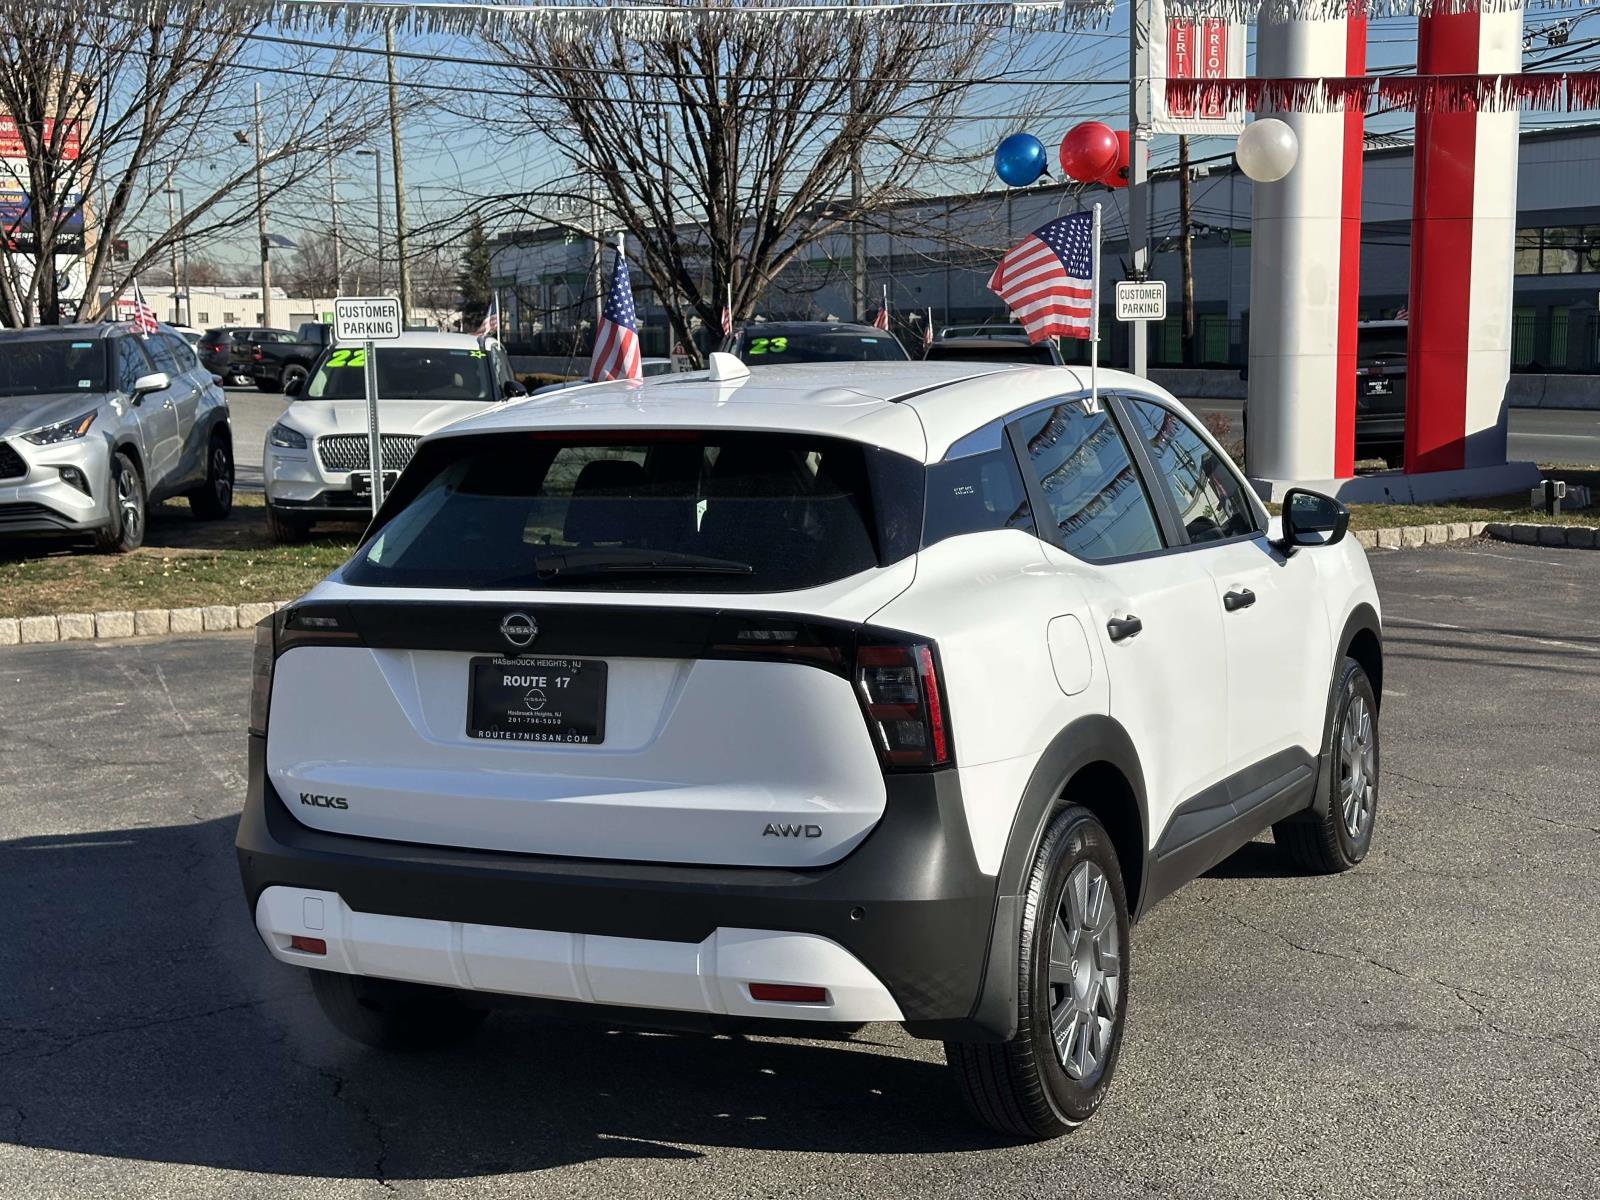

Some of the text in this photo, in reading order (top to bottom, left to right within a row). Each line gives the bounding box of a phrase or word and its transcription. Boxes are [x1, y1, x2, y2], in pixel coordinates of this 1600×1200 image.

[1120, 288, 1162, 300] CUSTOMER
[339, 305, 396, 318] CUSTOMER
[1122, 303, 1159, 314] PARKING
[343, 322, 393, 334] PARKING
[749, 337, 788, 355] 23
[501, 625, 538, 635] NISSAN
[492, 657, 536, 666] HASBROUCK
[572, 660, 582, 668] NJ
[503, 675, 571, 688] ROUTE 17
[478, 730, 589, 743] ROUTE17NISSAN.COM
[300, 792, 349, 810] KICKS
[762, 823, 823, 838] AWD
